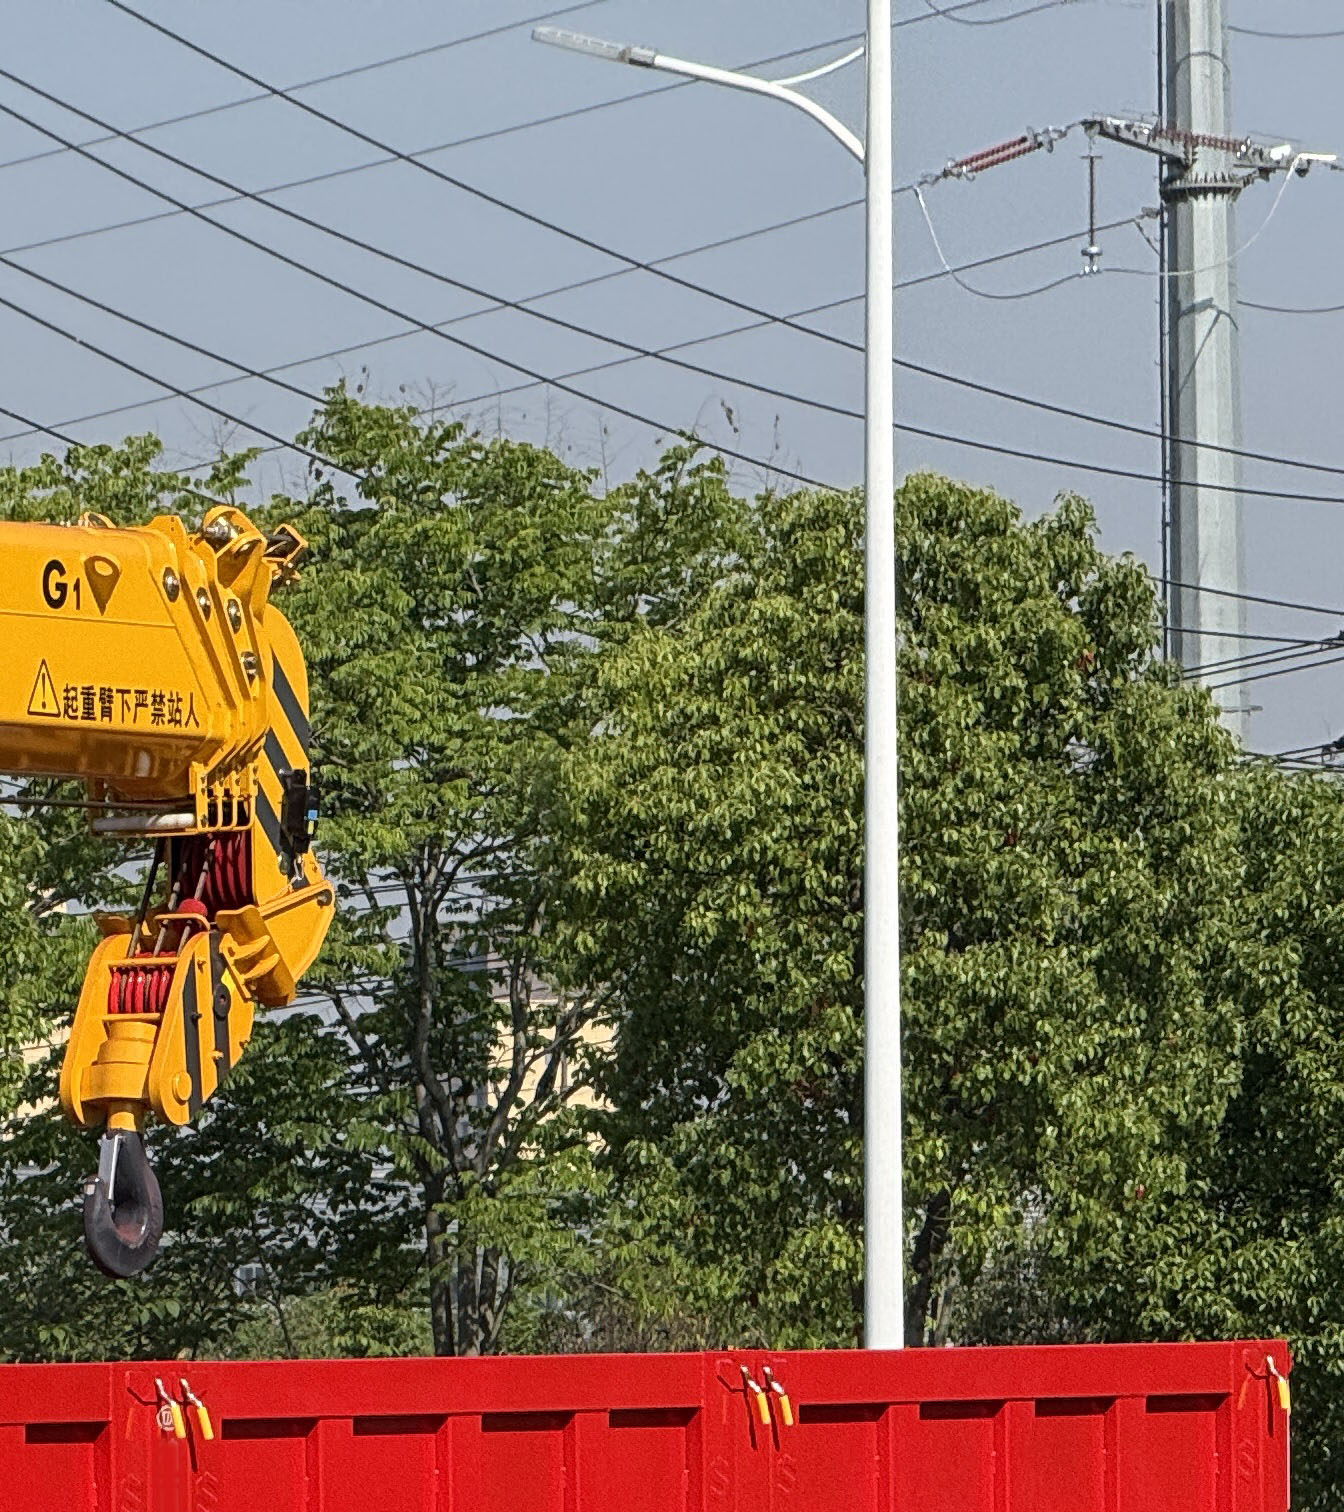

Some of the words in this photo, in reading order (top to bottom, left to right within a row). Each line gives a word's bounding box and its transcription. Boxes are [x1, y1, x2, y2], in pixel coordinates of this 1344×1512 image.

[63, 683, 200, 729] 起重臂下严禁站人
